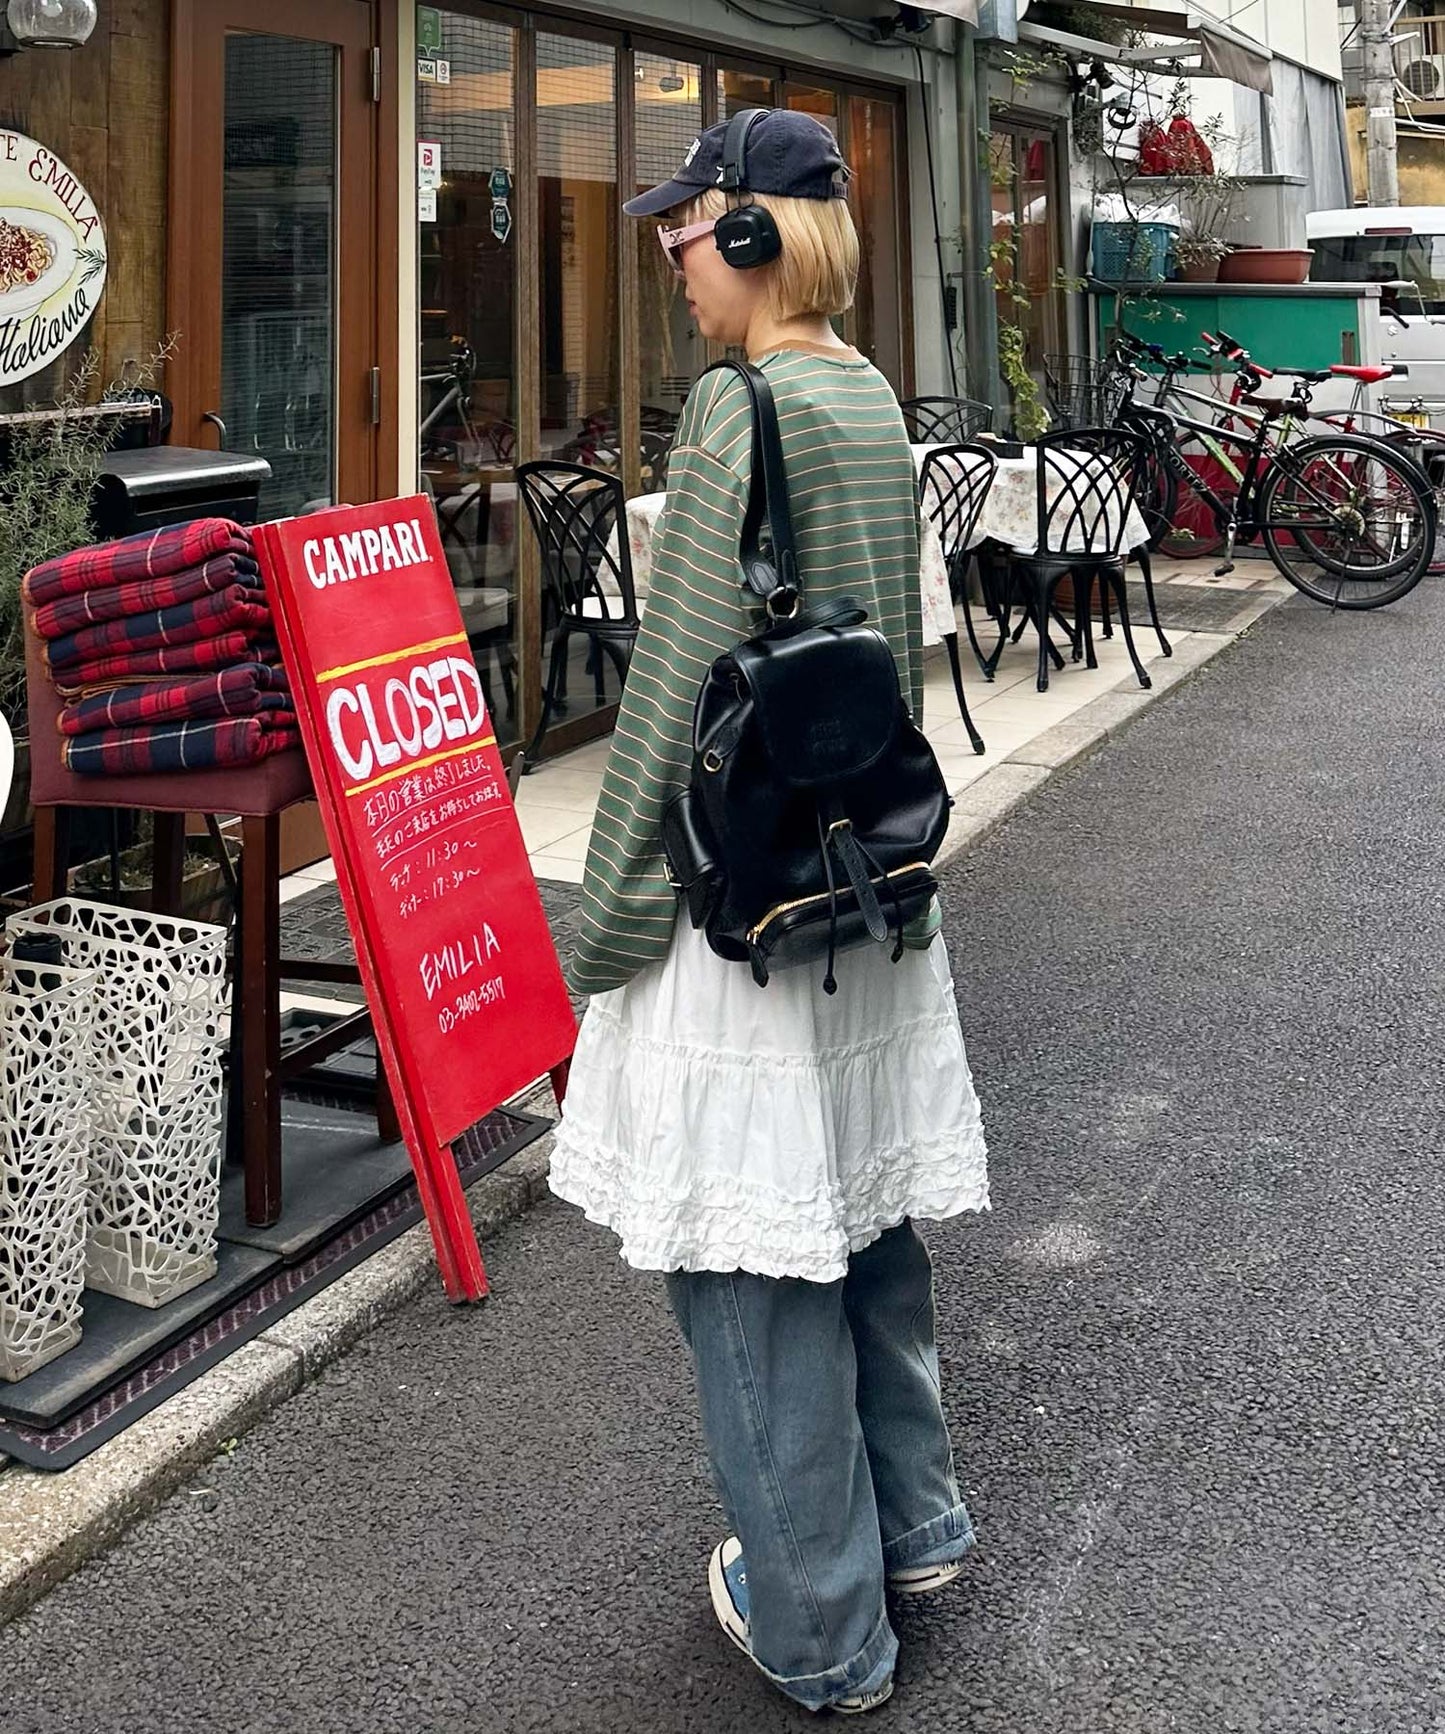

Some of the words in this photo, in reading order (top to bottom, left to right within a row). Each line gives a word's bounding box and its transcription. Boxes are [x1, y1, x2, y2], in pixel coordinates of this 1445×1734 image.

[418, 62, 433, 74] VISA
[28, 148, 98, 243] EMILIA
[303, 518, 430, 590] CAMPARI
[326, 656, 485, 781] CLOSED
[419, 922, 501, 1001] EMILIA
[438, 976, 505, 1034] 03-3402-5517
